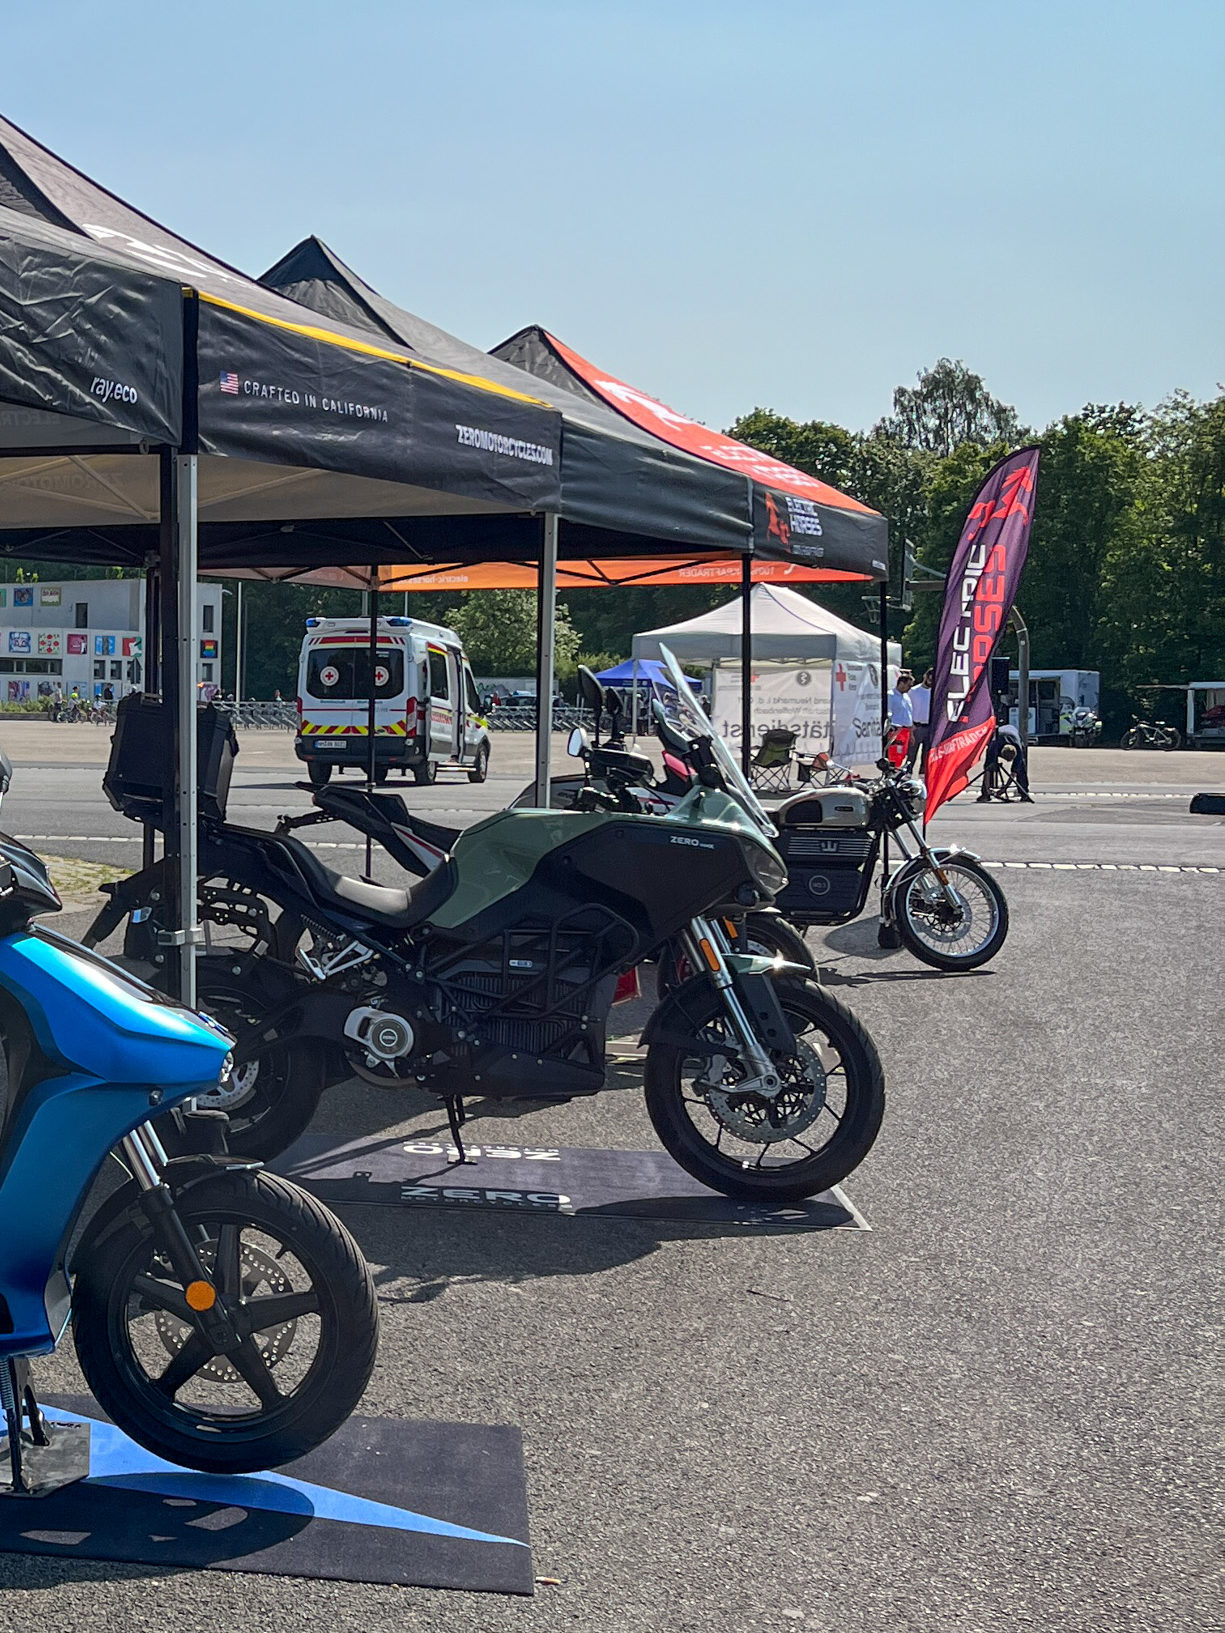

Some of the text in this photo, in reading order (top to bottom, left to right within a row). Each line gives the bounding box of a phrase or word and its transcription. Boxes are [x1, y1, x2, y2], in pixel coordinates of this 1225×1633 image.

[90, 376, 138, 404] ray.eco
[243, 380, 389, 422] CRAFTED IN CALIFORNIA
[669, 835, 699, 846] ZERO
[401, 1186, 571, 1204] ZERO
